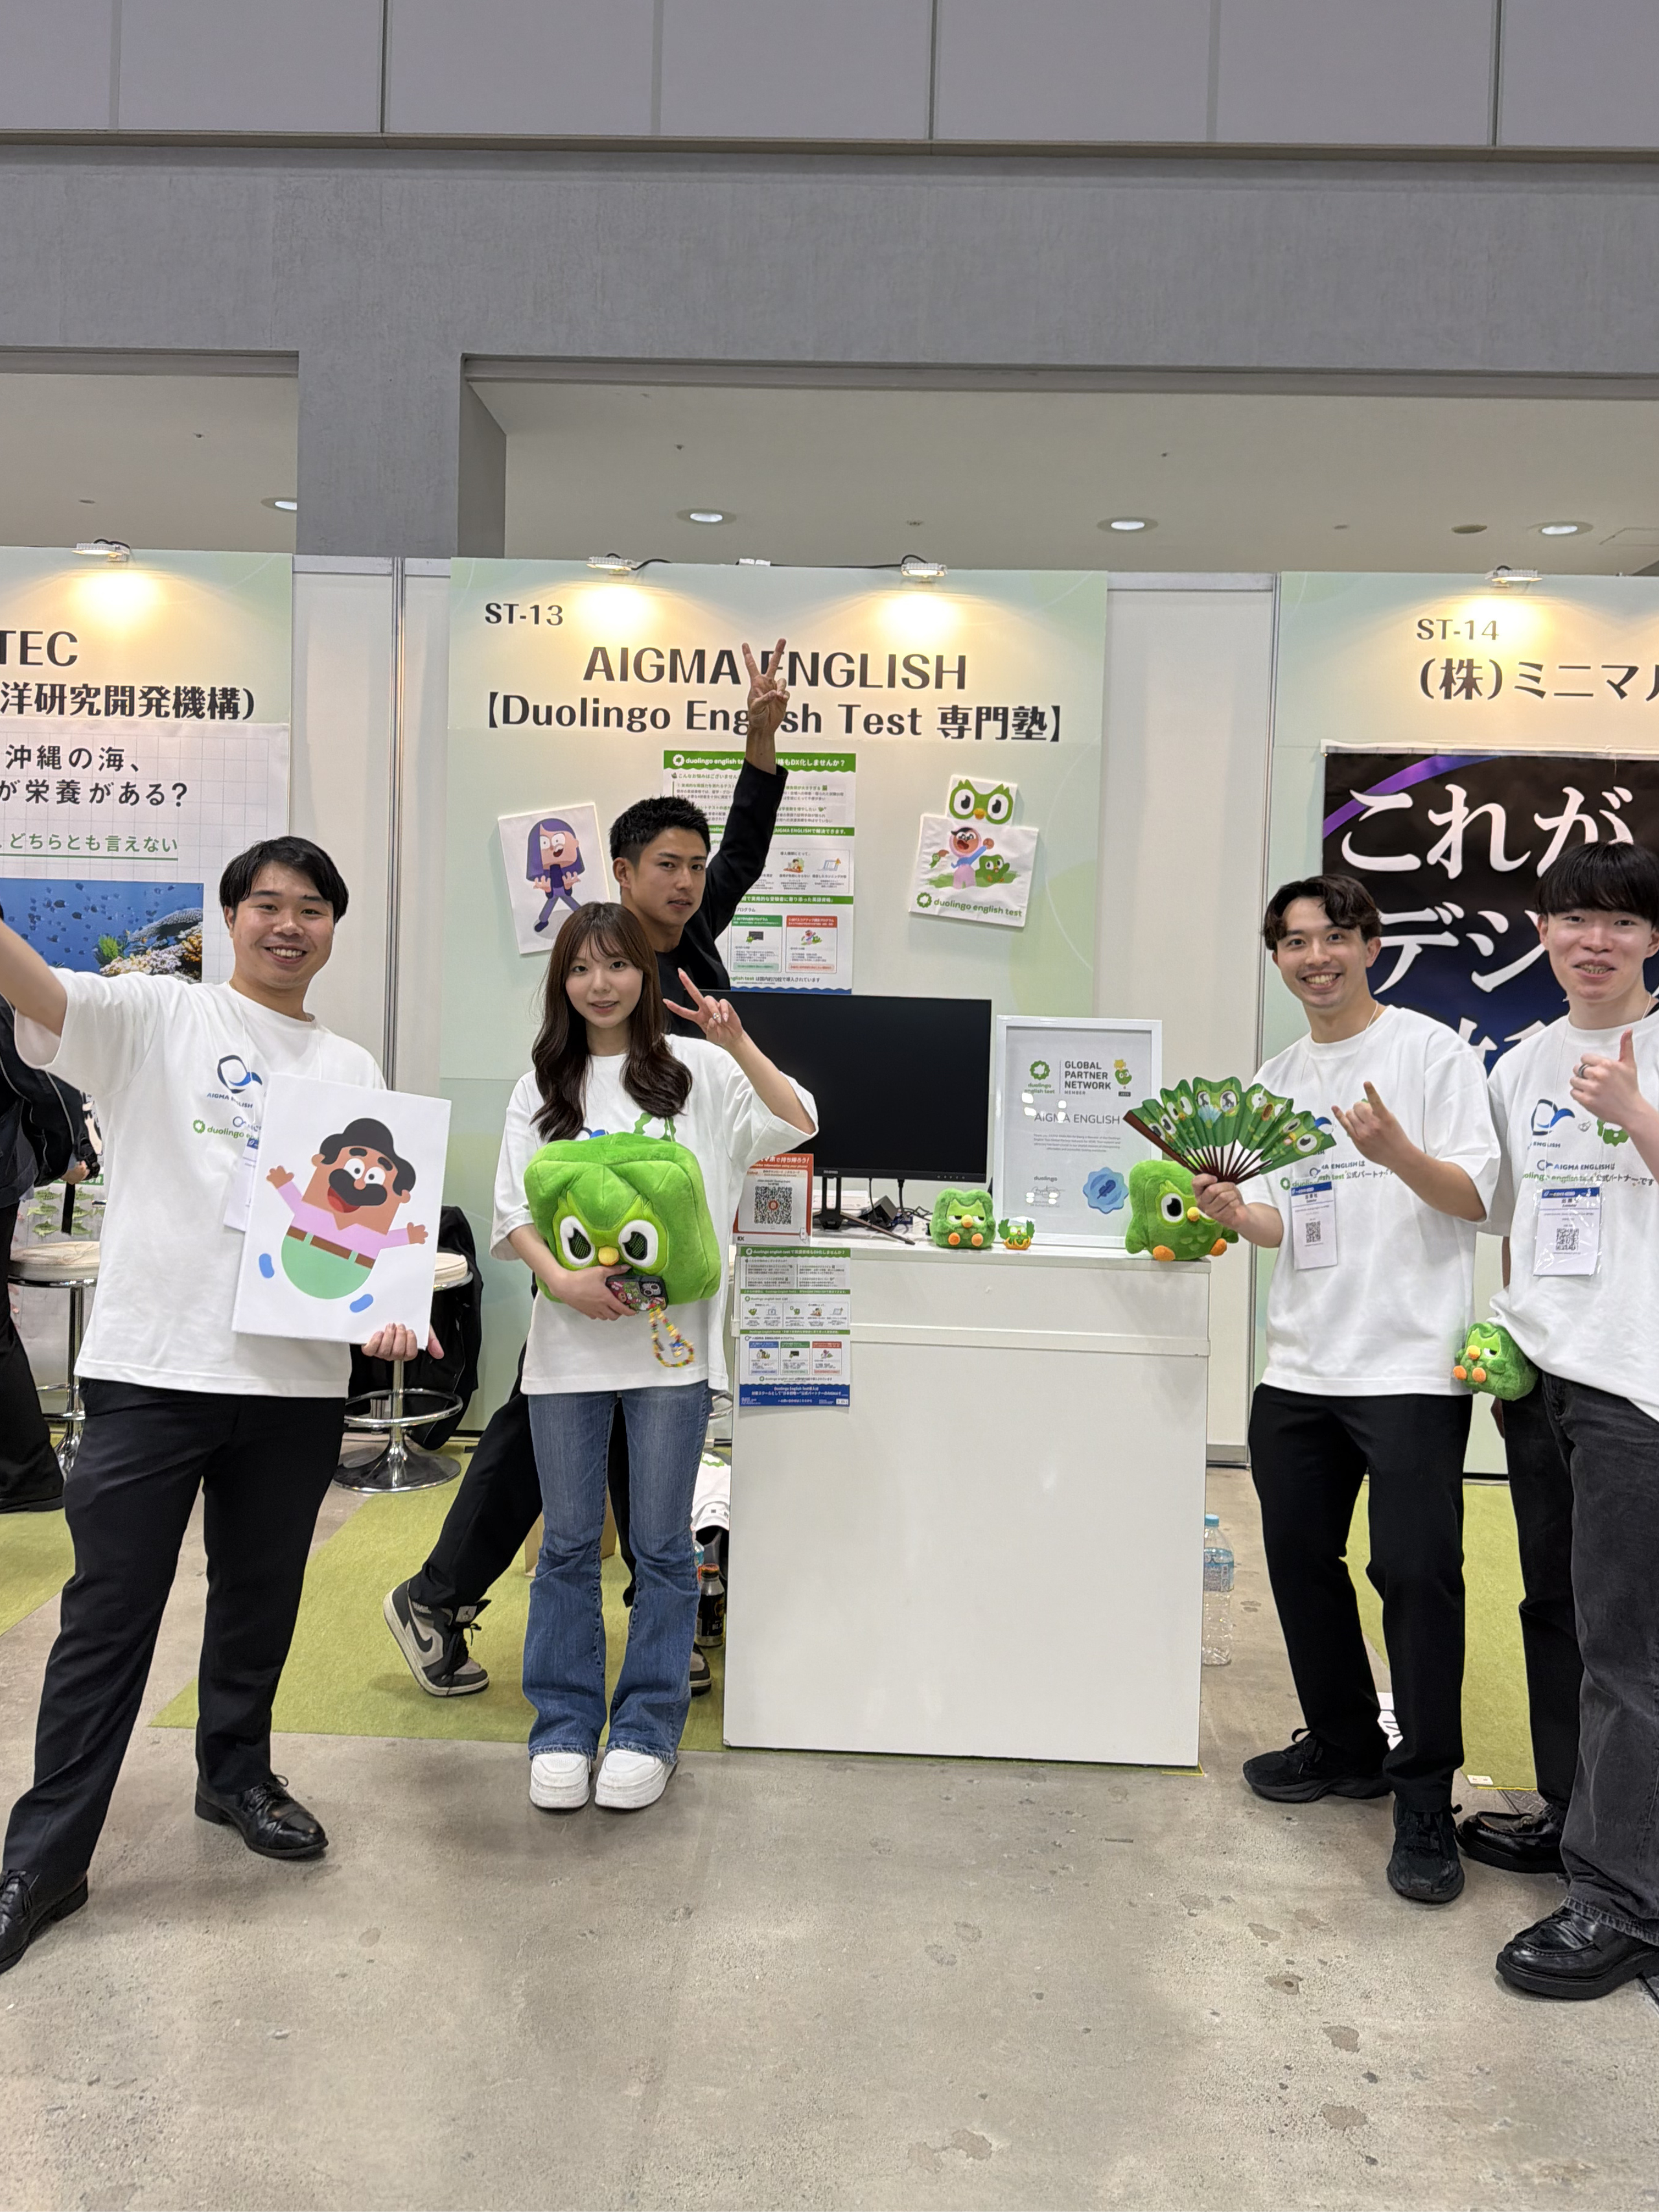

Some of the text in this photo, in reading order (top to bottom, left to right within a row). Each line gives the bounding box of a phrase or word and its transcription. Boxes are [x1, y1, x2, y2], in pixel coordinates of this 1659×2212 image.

[485, 602, 564, 625] ST-13
[1417, 619, 1499, 640] ST-14
[0, 630, 78, 667] TEC
[583, 646, 741, 685] AIGMA
[687, 700, 821, 736] Engsh
[838, 704, 922, 736] Test
[936, 704, 1061, 742] 専門塾】
[5, 745, 139, 772] 沖縄の海、
[686, 758, 713, 766] duolingo
[714, 758, 736, 766] english
[1341, 784, 1633, 879] これが
[934, 899, 1022, 917] duolingo english test
[1065, 1061, 1102, 1069] GLOBAL
[1065, 1071, 1108, 1080] PARTNER
[1065, 1081, 1111, 1090] NETWORK
[1073, 1114, 1120, 1124] ENGLISH
[207, 1126, 245, 1139] duolingo
